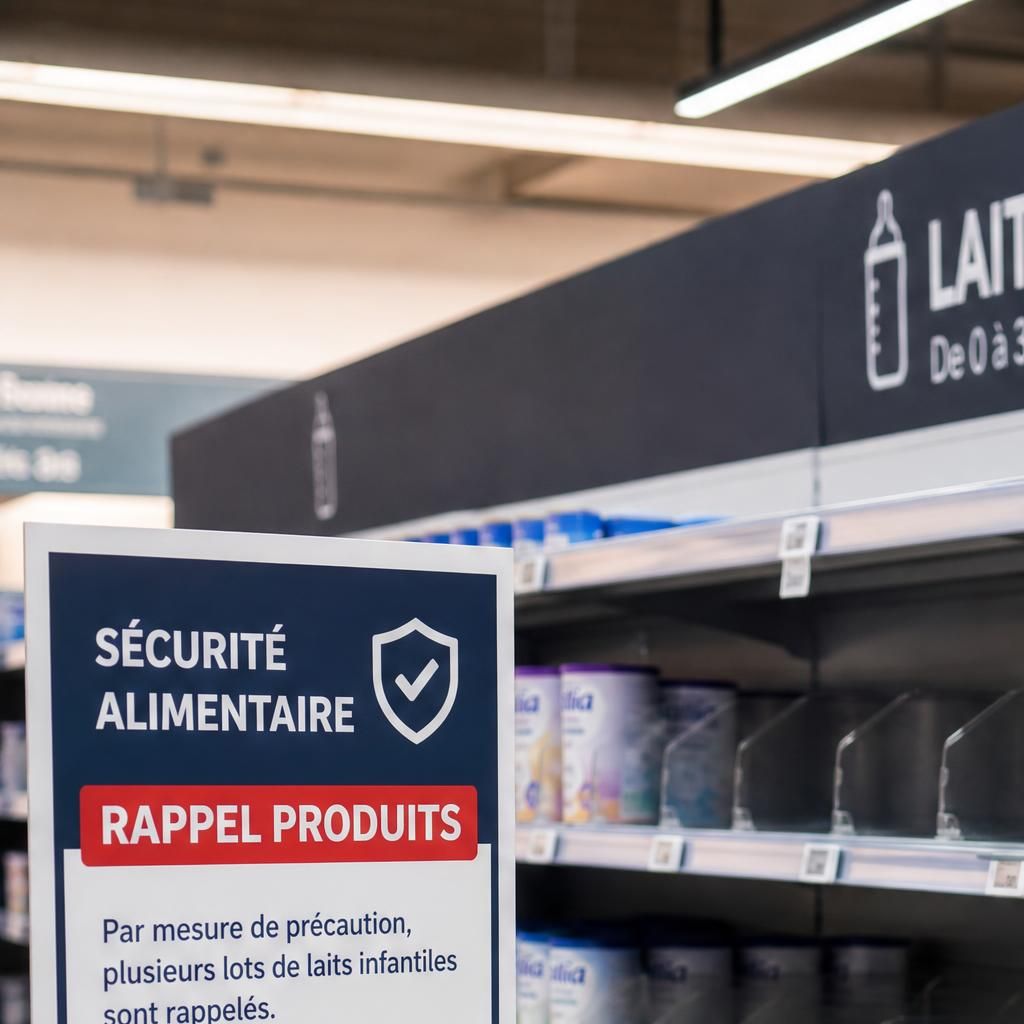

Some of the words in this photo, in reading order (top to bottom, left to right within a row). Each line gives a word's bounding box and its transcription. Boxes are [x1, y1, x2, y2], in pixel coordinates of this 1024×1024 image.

[930, 334, 965, 384] De
[968, 325, 988, 375] 0
[991, 320, 1009, 370] à
[95, 619, 287, 671] SÉCURITÉ
[95, 691, 355, 733] ALIMENTAIRE
[102, 804, 262, 845] RAPPEL
[273, 803, 462, 843] PRODUITS
[103, 918, 145, 943] Par
[153, 919, 243, 941] mesure
[250, 914, 279, 938] de
[286, 911, 412, 944] précaution,
[103, 958, 216, 992] plusieurs
[223, 955, 265, 981] lots
[272, 954, 300, 979] de
[307, 952, 353, 977] laits
[359, 948, 458, 975] infantiles
